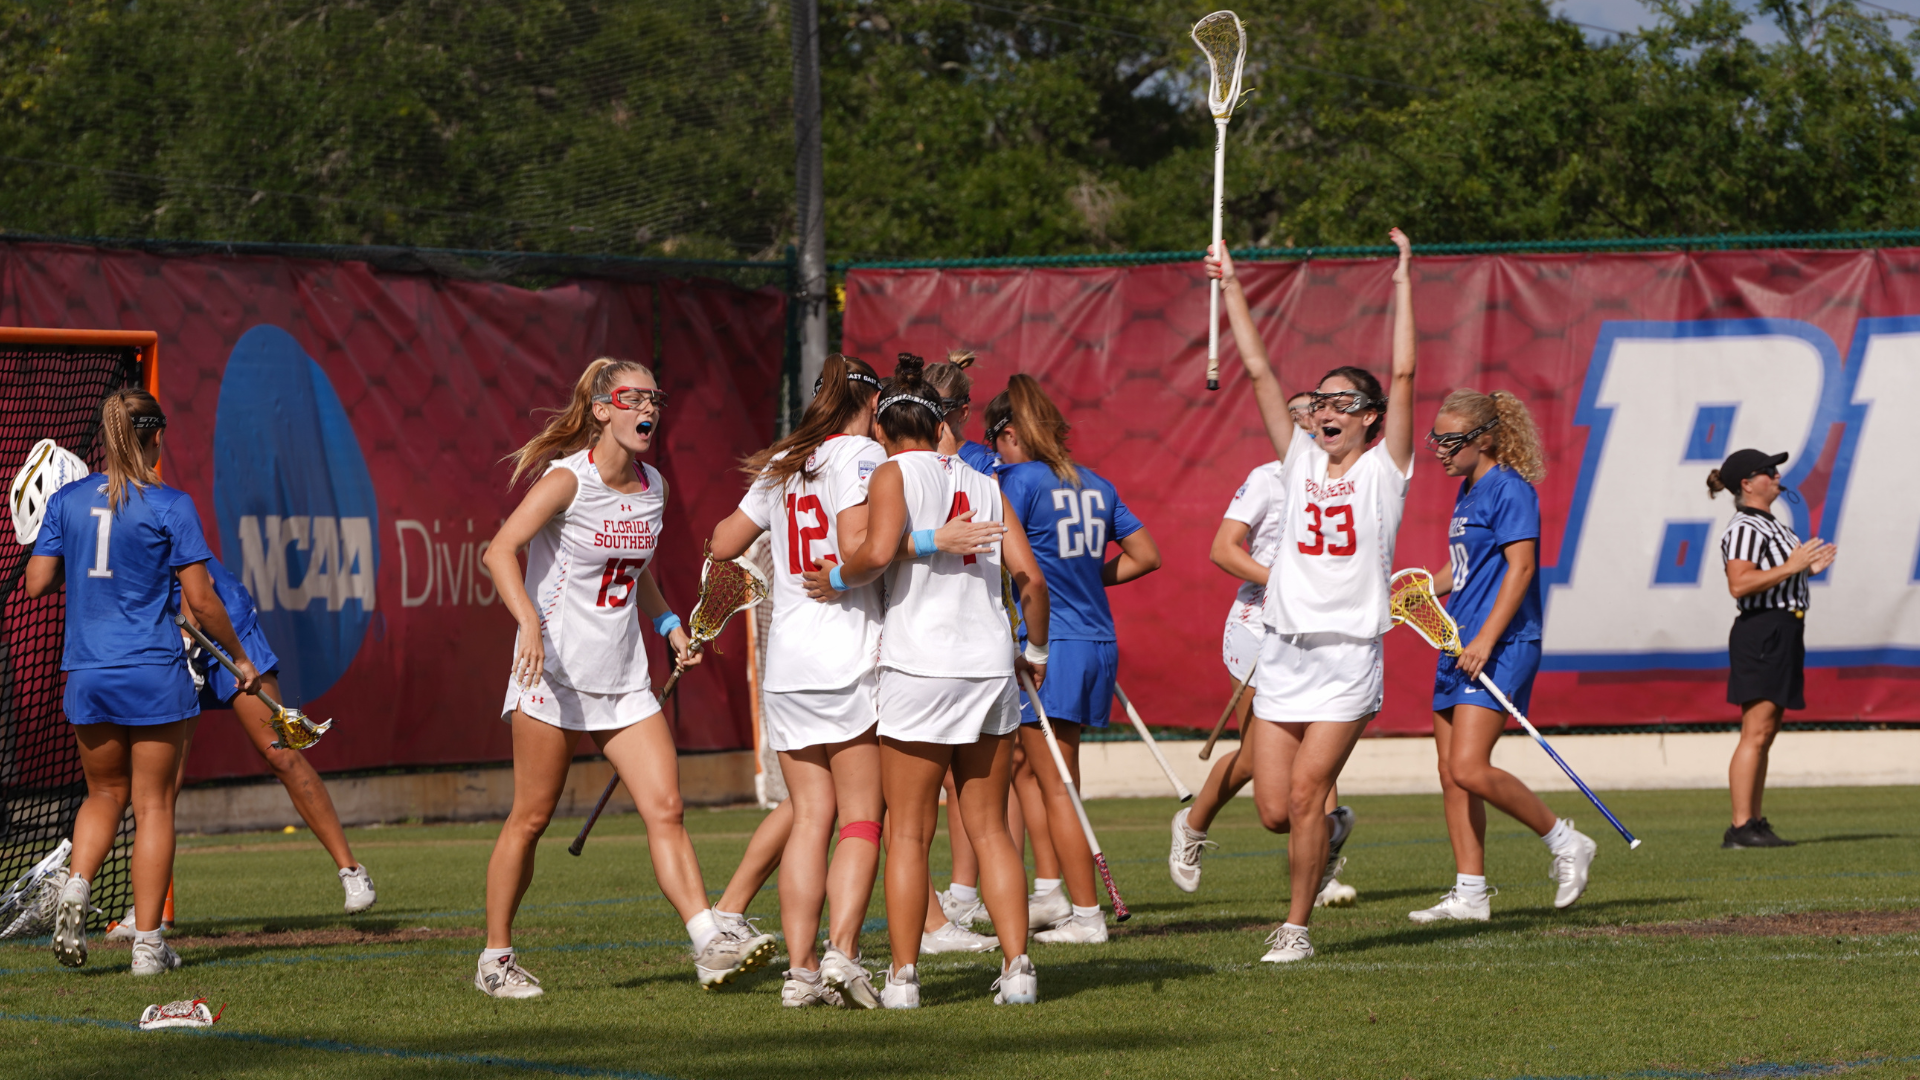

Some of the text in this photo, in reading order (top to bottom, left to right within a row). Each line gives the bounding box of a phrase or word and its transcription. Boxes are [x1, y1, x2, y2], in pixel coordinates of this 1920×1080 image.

[88, 506, 114, 579] 1
[594, 532, 657, 550] SOUTHERN
[603, 519, 651, 534] FLORIDA
[787, 493, 839, 575] 12
[1051, 488, 1106, 559] 26
[1297, 502, 1357, 556] 33
[239, 515, 375, 612] NCAA
[396, 518, 529, 607] Divis
[596, 557, 646, 608] 15
